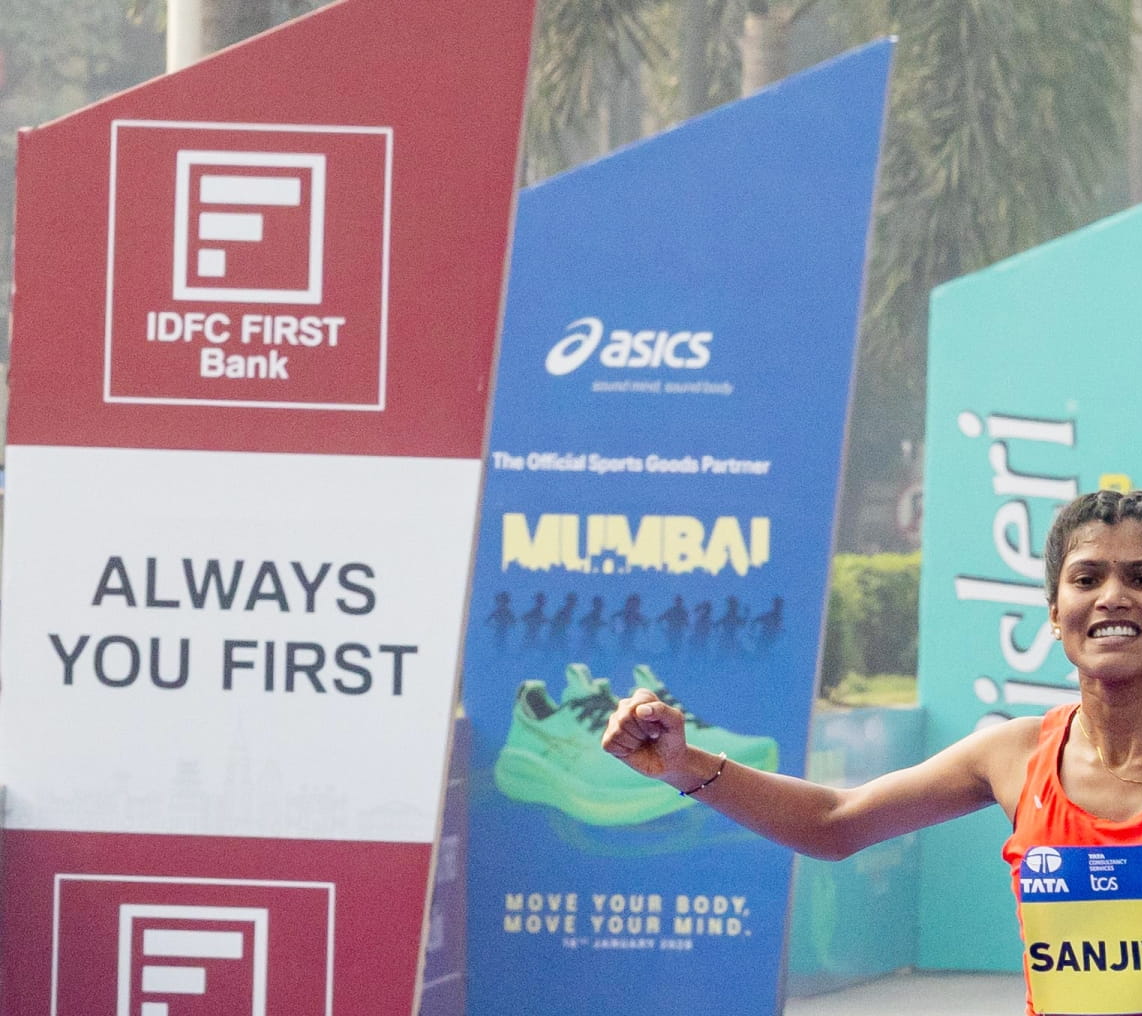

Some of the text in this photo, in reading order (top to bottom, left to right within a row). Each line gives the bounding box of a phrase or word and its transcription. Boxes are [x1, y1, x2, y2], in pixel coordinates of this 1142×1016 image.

[147, 312, 346, 348] IDFC FIRST
[200, 348, 289, 380] Bank
[601, 330, 713, 369] asics
[493, 452, 525, 471] The
[526, 453, 586, 472] Official
[588, 454, 643, 475] Sports
[701, 456, 771, 475] Partner
[502, 512, 771, 576] MUMBAI
[92, 556, 377, 616] ALWAYS
[955, 410, 1078, 731] isleri
[49, 634, 419, 697] YOU FIRST
[1020, 878, 1070, 894] TATA
[1090, 874, 1119, 891] tcs
[505, 894, 749, 918] MOVE YOUR BODY,
[503, 914, 751, 937] MOVE YOUR MIND.
